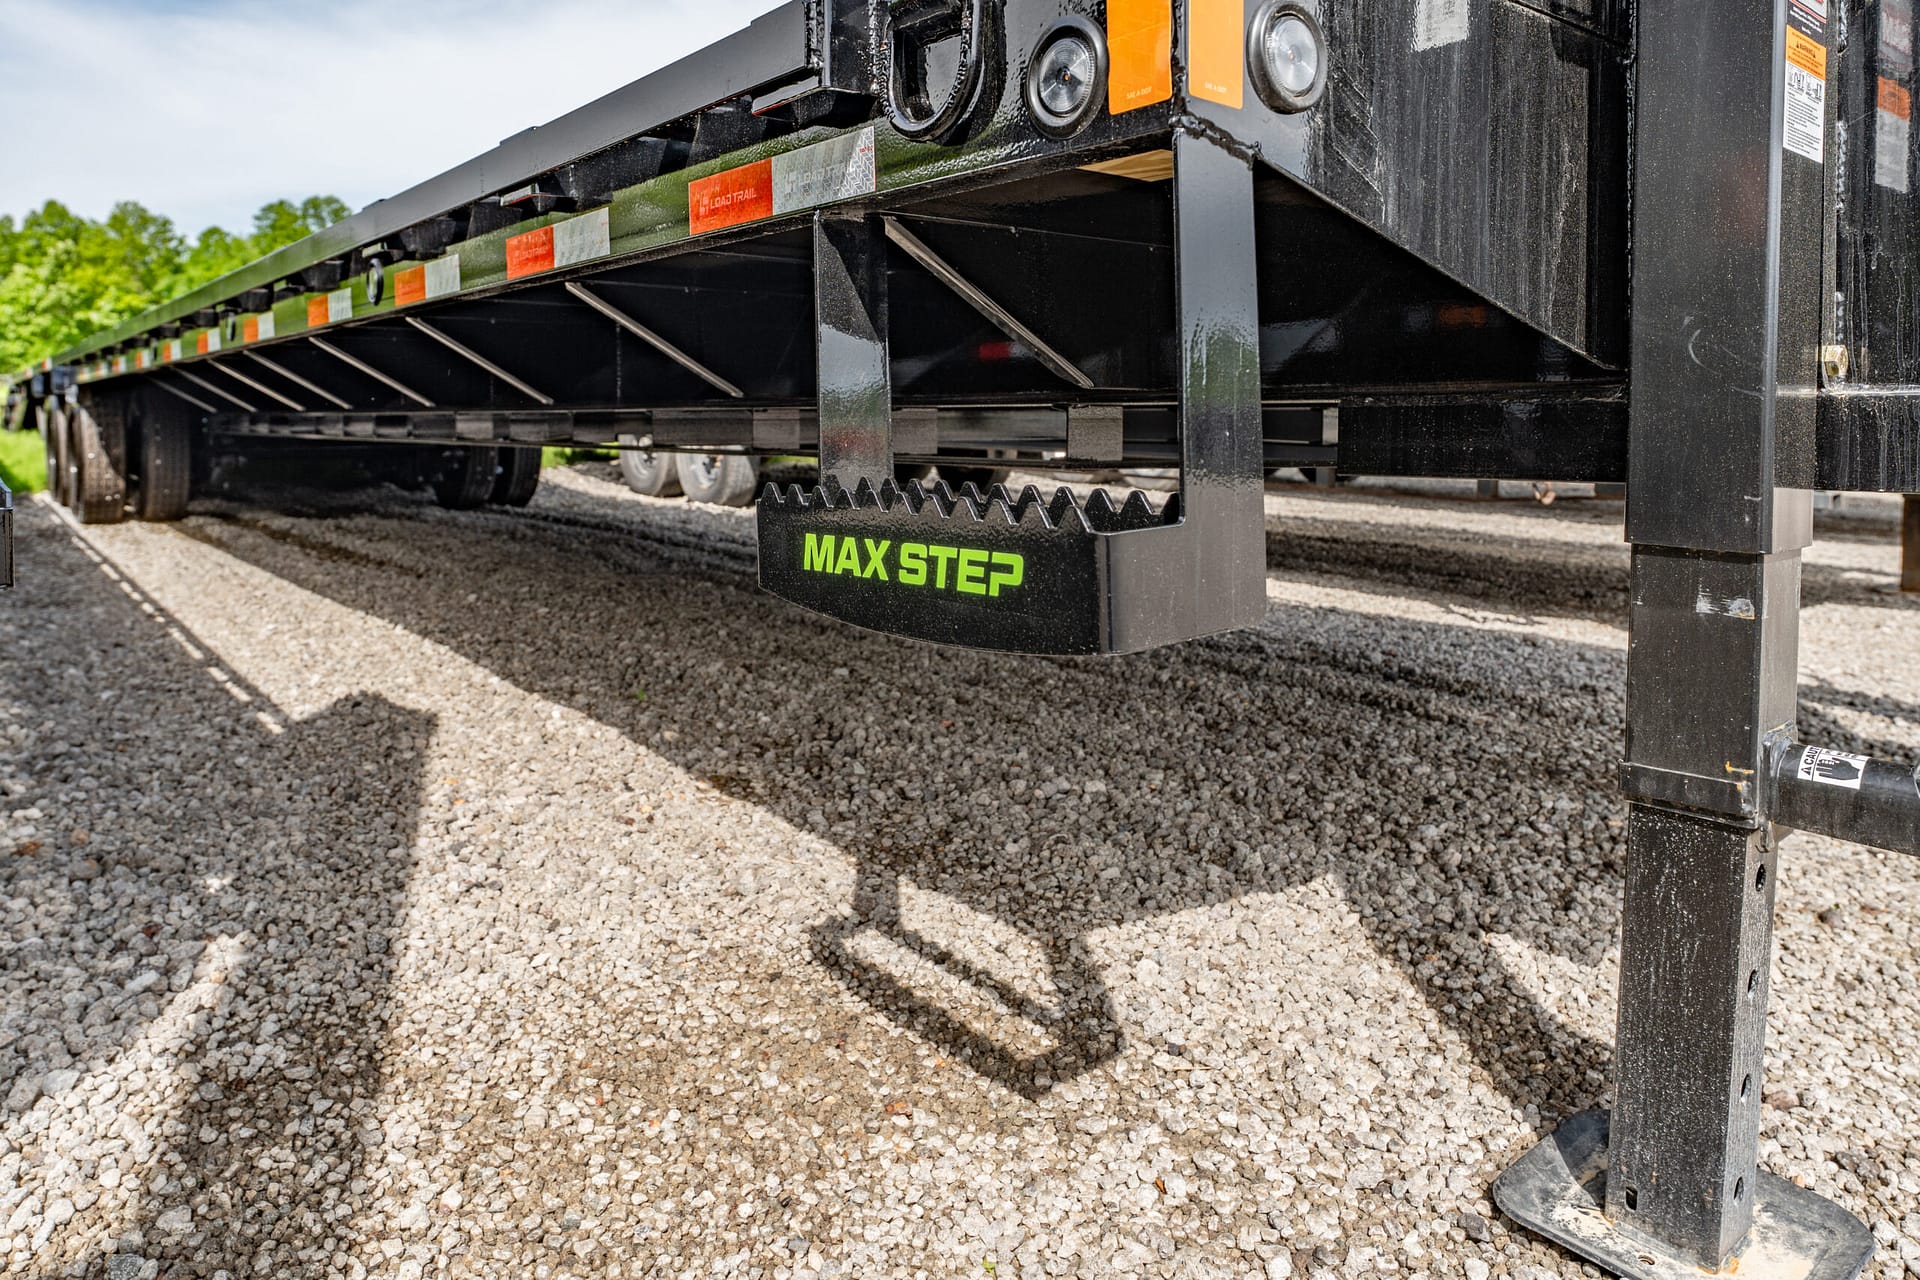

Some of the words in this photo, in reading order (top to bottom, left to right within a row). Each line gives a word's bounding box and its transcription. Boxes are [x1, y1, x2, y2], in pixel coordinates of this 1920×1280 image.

[710, 193, 732, 209] LOAD
[733, 187, 757, 203] TRAIL
[803, 533, 891, 581] MAX
[899, 542, 1024, 597] STEP
